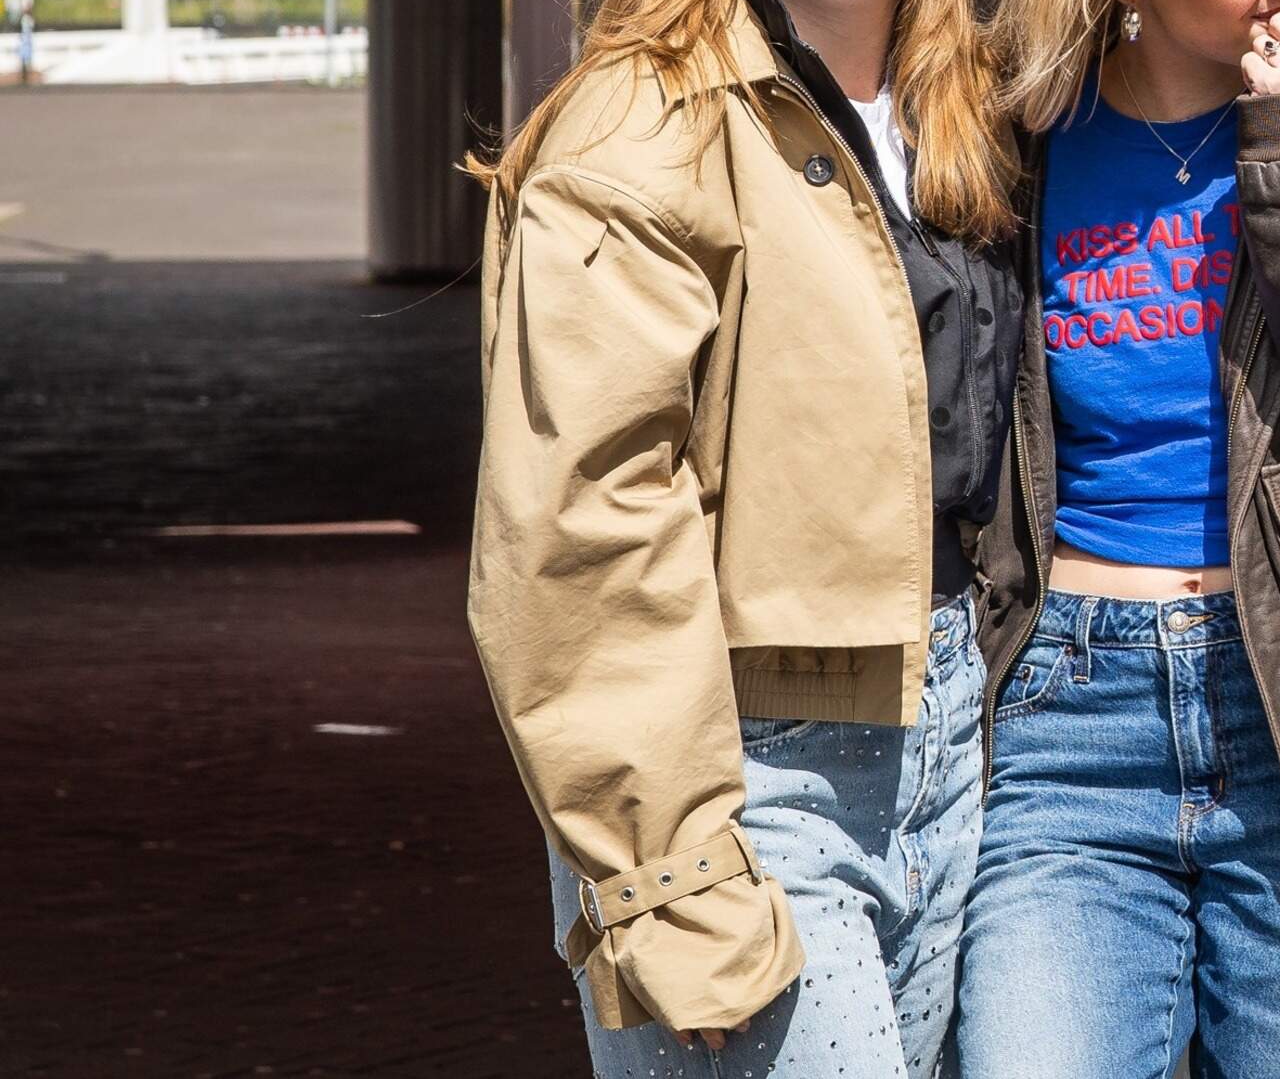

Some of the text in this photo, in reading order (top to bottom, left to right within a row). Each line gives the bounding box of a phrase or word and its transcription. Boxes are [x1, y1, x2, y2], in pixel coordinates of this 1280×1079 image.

[1057, 222, 1138, 266] KISS
[1147, 211, 1215, 251] ALL
[1063, 249, 1233, 304] TIME. DIS
